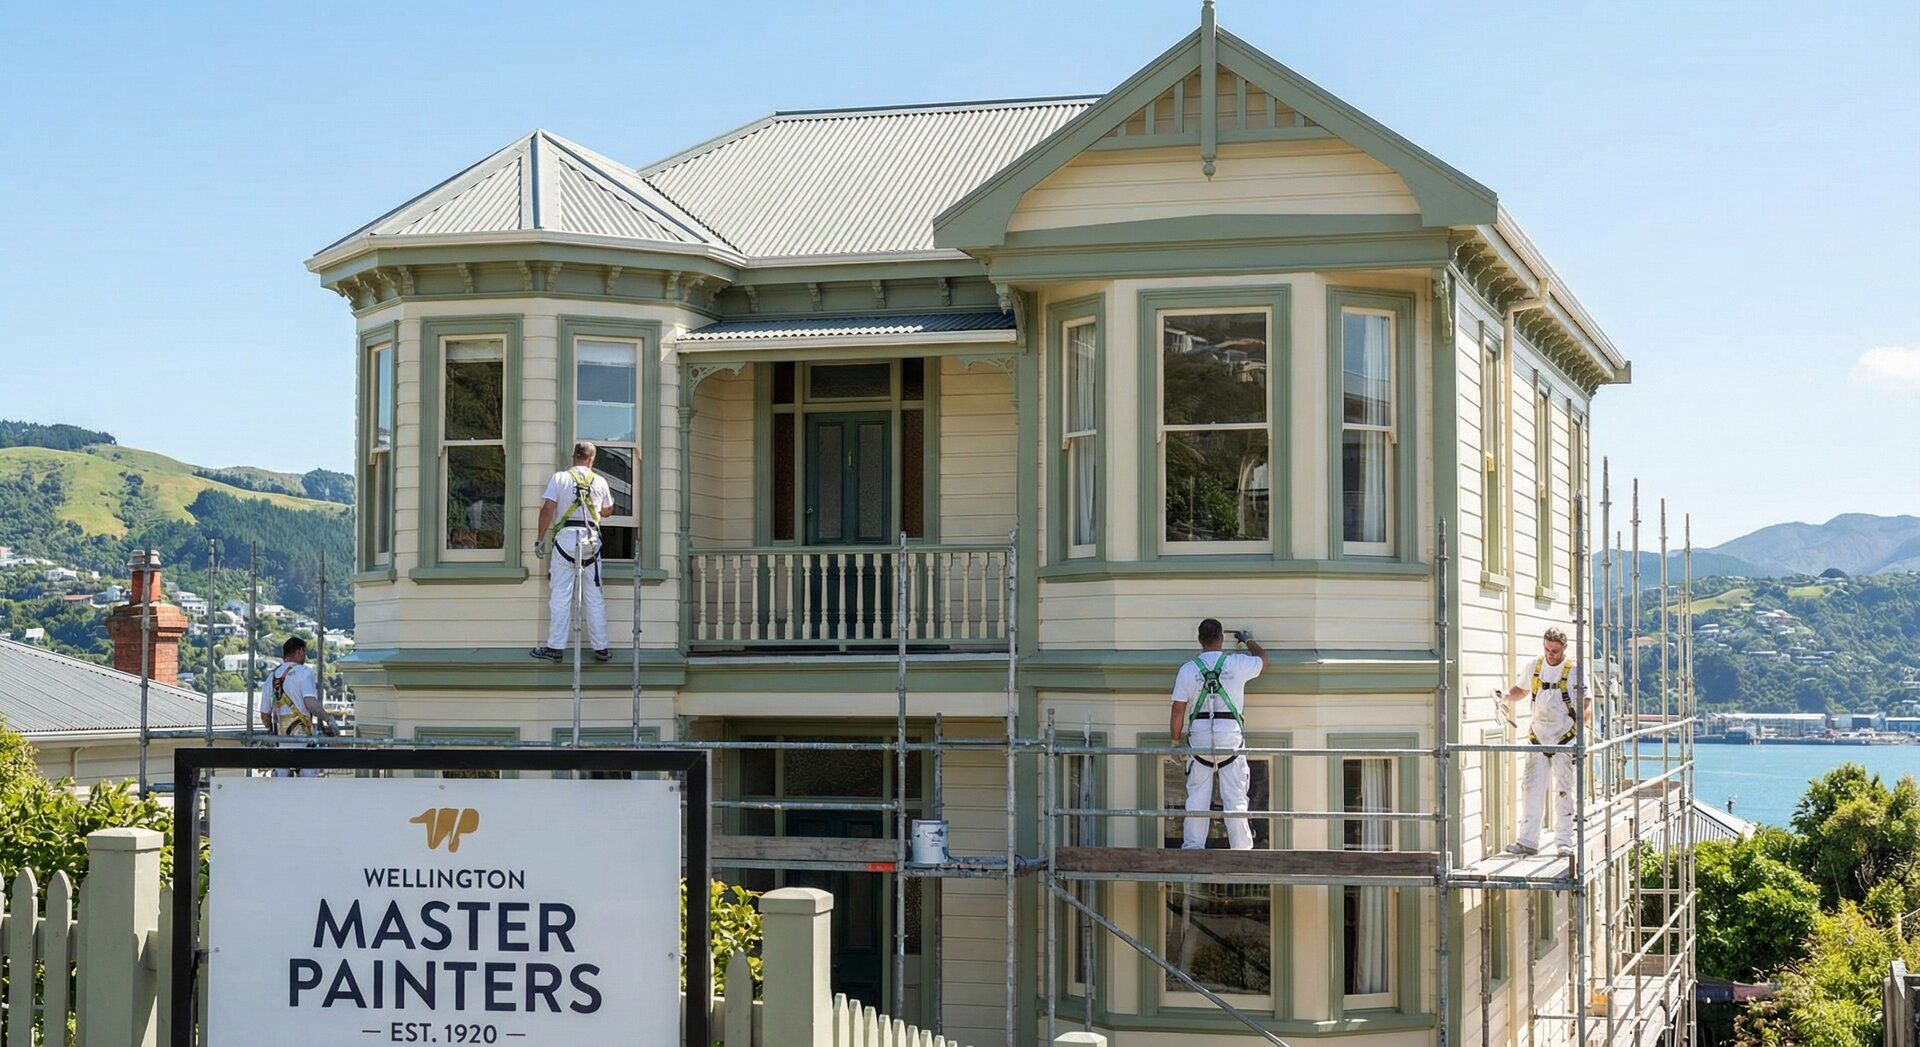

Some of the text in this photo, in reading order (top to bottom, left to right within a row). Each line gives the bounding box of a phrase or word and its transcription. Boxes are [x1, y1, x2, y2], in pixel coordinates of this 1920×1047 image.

[363, 867, 525, 890] WELLINGTON
[312, 898, 576, 953] MASTER
[288, 957, 603, 1015] PAINTERS
[391, 1021, 498, 1045] EST. 1920
